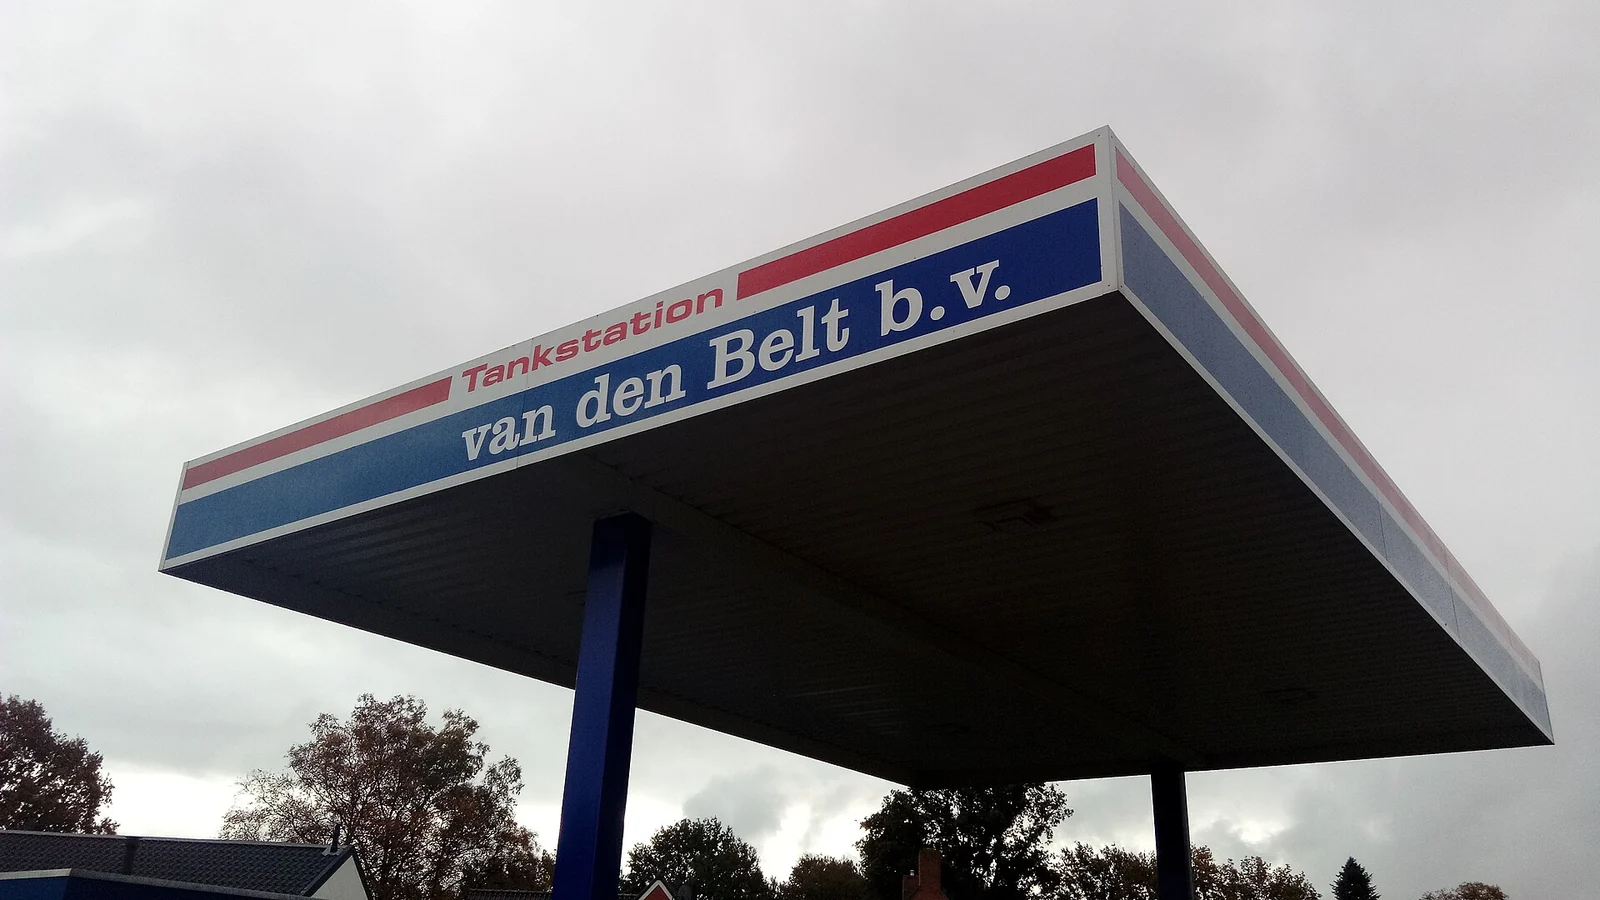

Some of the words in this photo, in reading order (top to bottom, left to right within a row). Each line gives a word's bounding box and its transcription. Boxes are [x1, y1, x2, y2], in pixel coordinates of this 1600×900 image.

[461, 288, 724, 392] Tankstation
[461, 404, 556, 461] van
[576, 364, 686, 428] den
[706, 298, 850, 390] Belt
[874, 259, 1011, 337] b.v.
